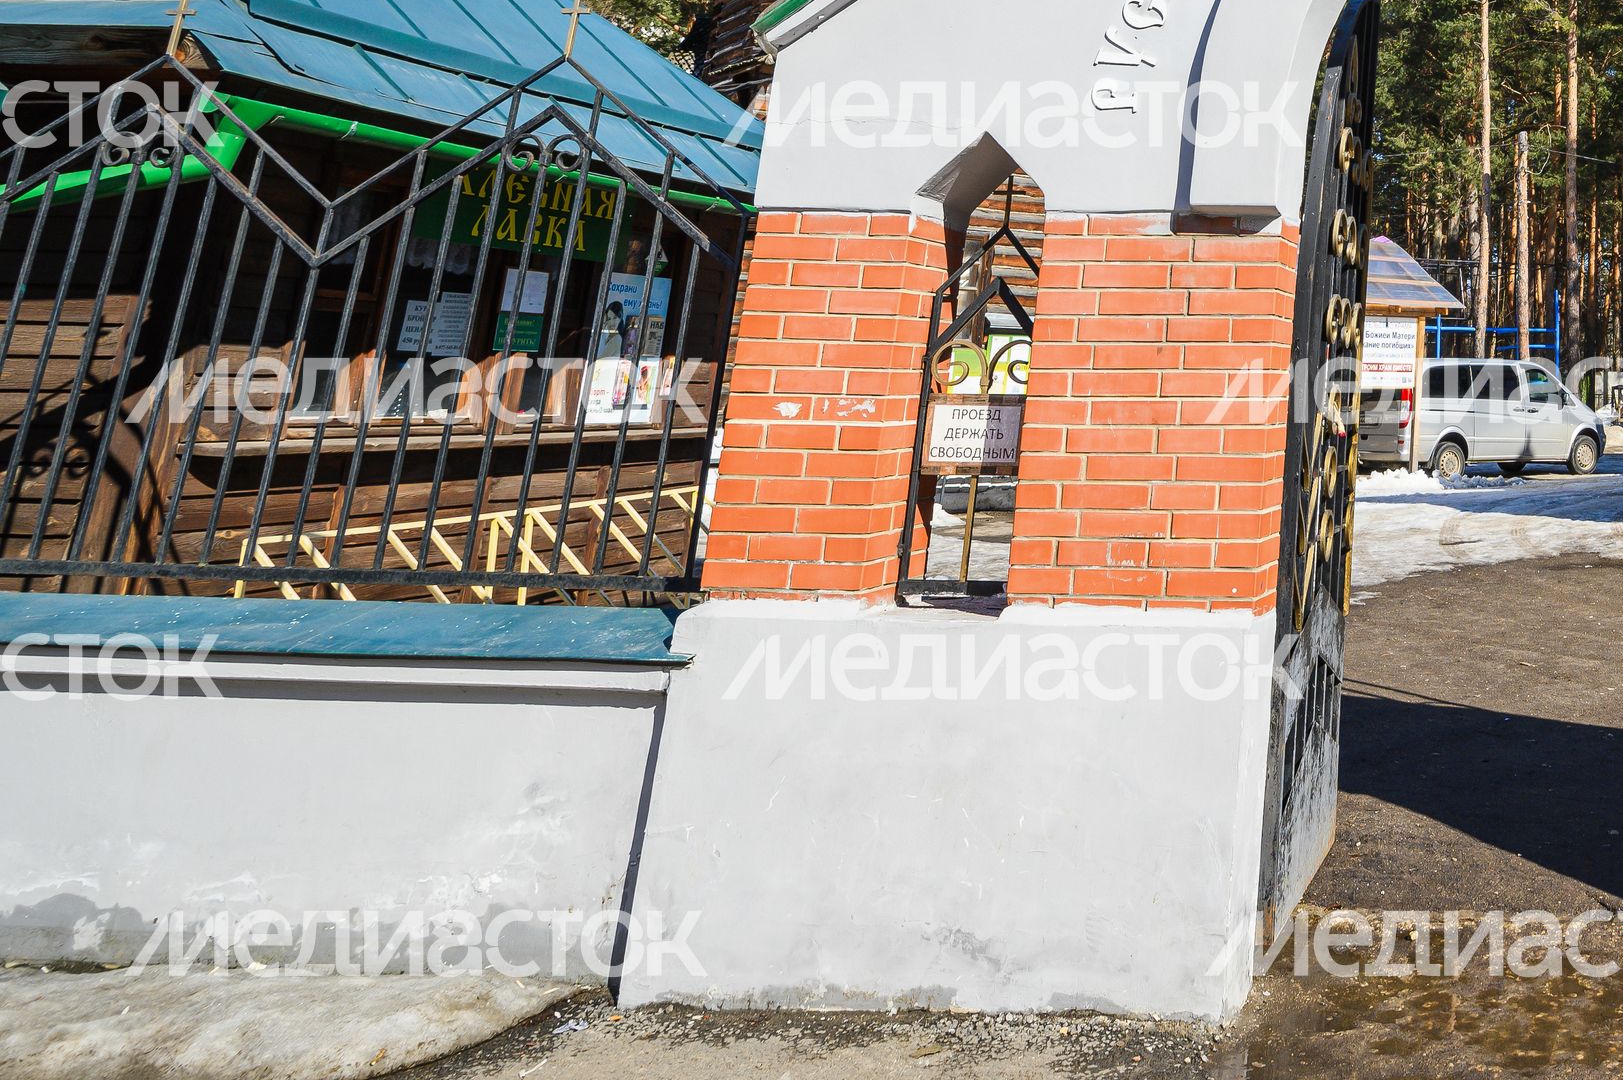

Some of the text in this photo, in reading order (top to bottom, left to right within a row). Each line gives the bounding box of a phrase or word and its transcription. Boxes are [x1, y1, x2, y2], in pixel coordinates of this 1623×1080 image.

[638, 300, 663, 310] знь!
[951, 408, 1002, 422] ПРОЕЗД
[944, 427, 1004, 441] ДЕРЖАТЬ
[930, 446, 1015, 461] СВОБОДНЫМ
